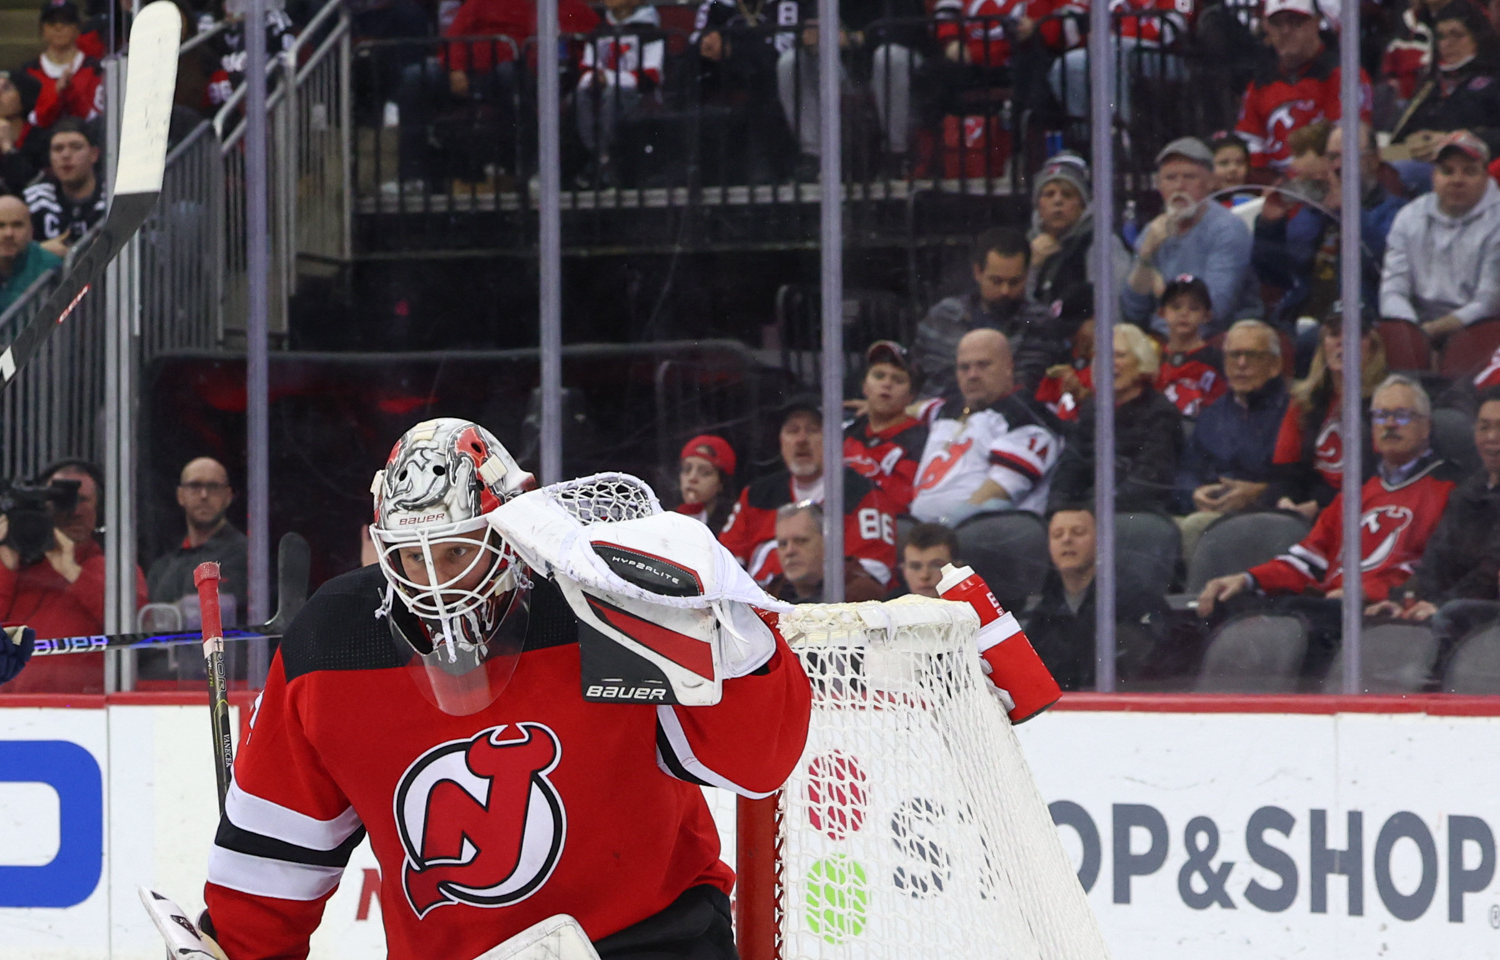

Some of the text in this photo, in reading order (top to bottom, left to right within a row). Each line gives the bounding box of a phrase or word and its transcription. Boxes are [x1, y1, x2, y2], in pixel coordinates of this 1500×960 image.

[399, 512, 445, 526] BAUER
[33, 635, 108, 655] AUER
[586, 685, 667, 701] BAUER
